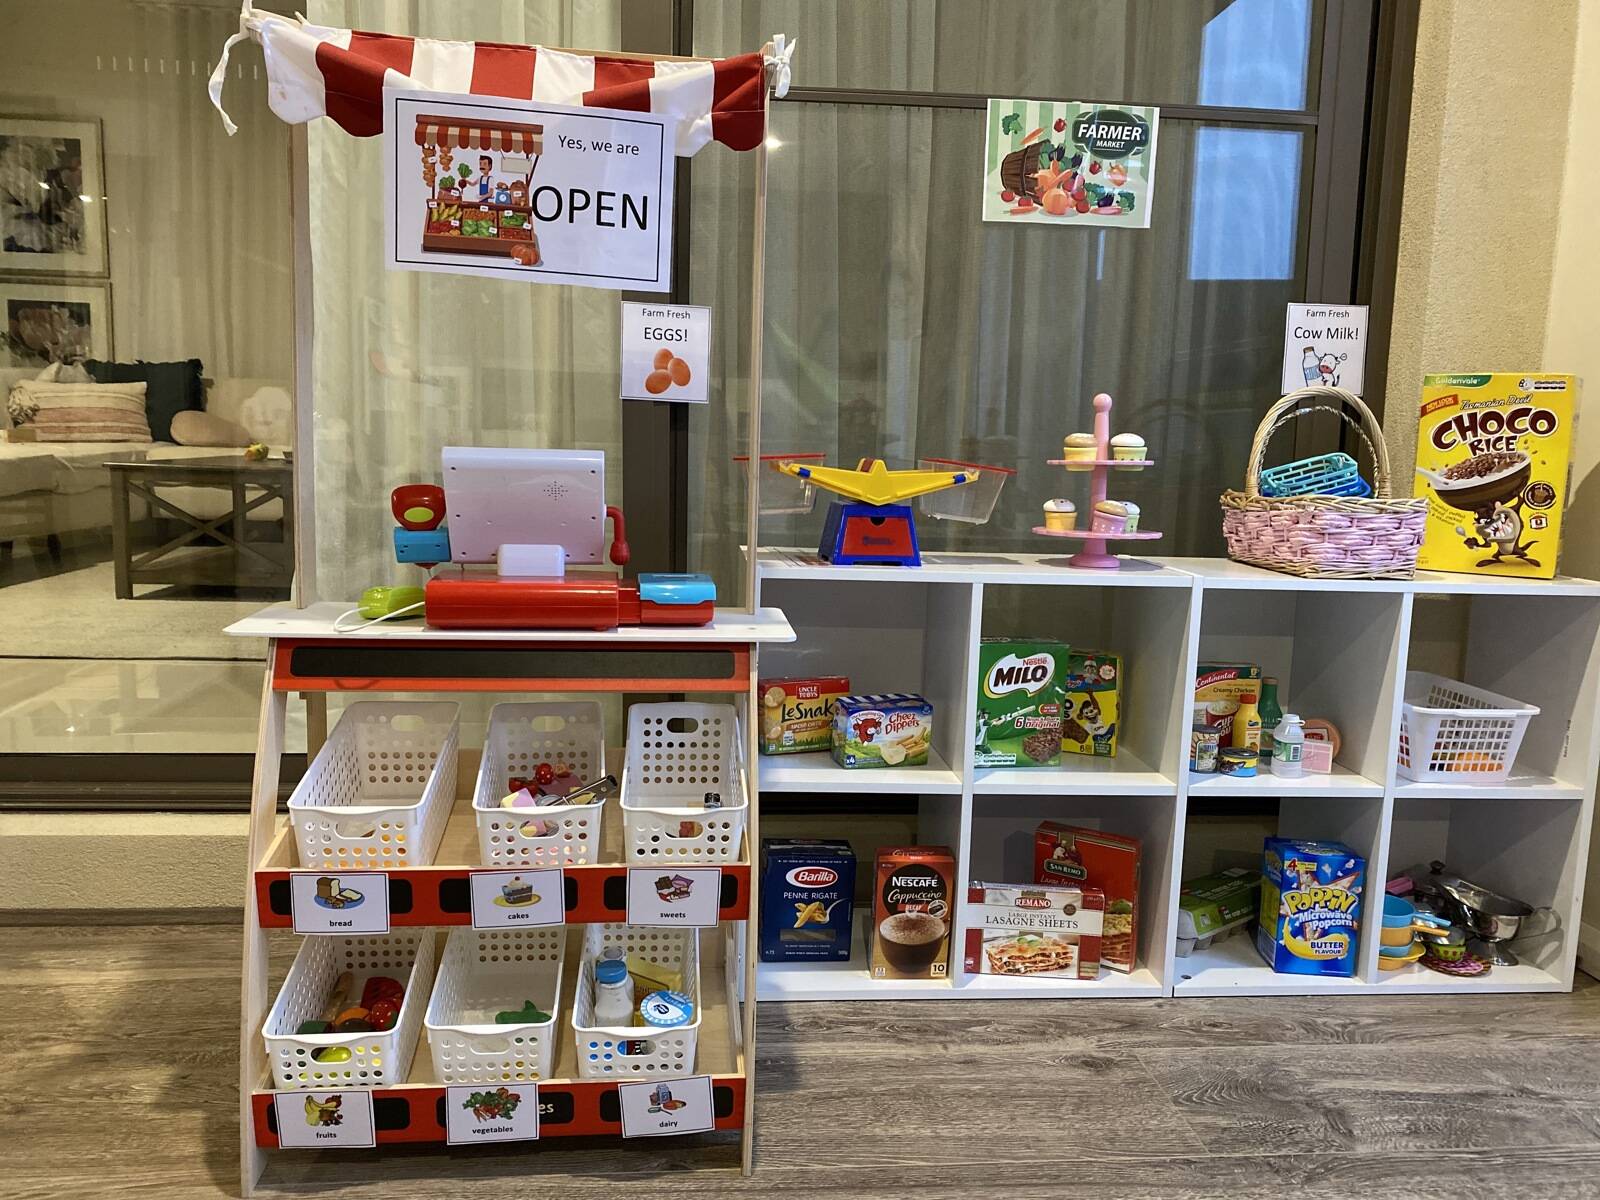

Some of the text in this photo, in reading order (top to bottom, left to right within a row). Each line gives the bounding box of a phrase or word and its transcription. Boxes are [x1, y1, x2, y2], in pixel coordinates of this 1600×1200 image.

[1078, 123, 1142, 141] FARMER
[558, 134, 640, 156] Yes, we are
[1096, 141, 1125, 149] MARKET
[532, 185, 649, 231] OPEN
[642, 308, 691, 319] Farm Fresh
[1306, 309, 1350, 318] Farm Fresh
[644, 327, 688, 342] EGGS!
[1294, 326, 1359, 340] Cow Milk!
[1460, 398, 1505, 410] Tasmanian
[1506, 393, 1533, 405] Devil
[1432, 407, 1557, 450] CHOCO
[1468, 435, 1519, 456] RICE
[993, 665, 1048, 687] MILO
[1196, 671, 1237, 688] Continental
[889, 712, 916, 723] Cheez
[1015, 717, 1023, 729] 6
[885, 720, 920, 735] Dippers
[1025, 720, 1060, 729] Original
[1050, 863, 1081, 875] SAN REMO
[1288, 858, 1297, 871] 4
[798, 871, 834, 882] Barilla
[783, 891, 809, 899] PENNE
[888, 889, 942, 903] Cappuccino
[1016, 897, 1050, 907] REMANO
[507, 912, 529, 920] cakes
[986, 915, 1079, 928] LASAGNE SHEETS
[1299, 910, 1352, 922] Microwave
[1312, 919, 1352, 930] Popcorn
[1310, 941, 1344, 949] BUTTER
[932, 964, 945, 972] 10
[316, 1131, 337, 1139] fruits
[472, 1126, 514, 1135] vegetables
